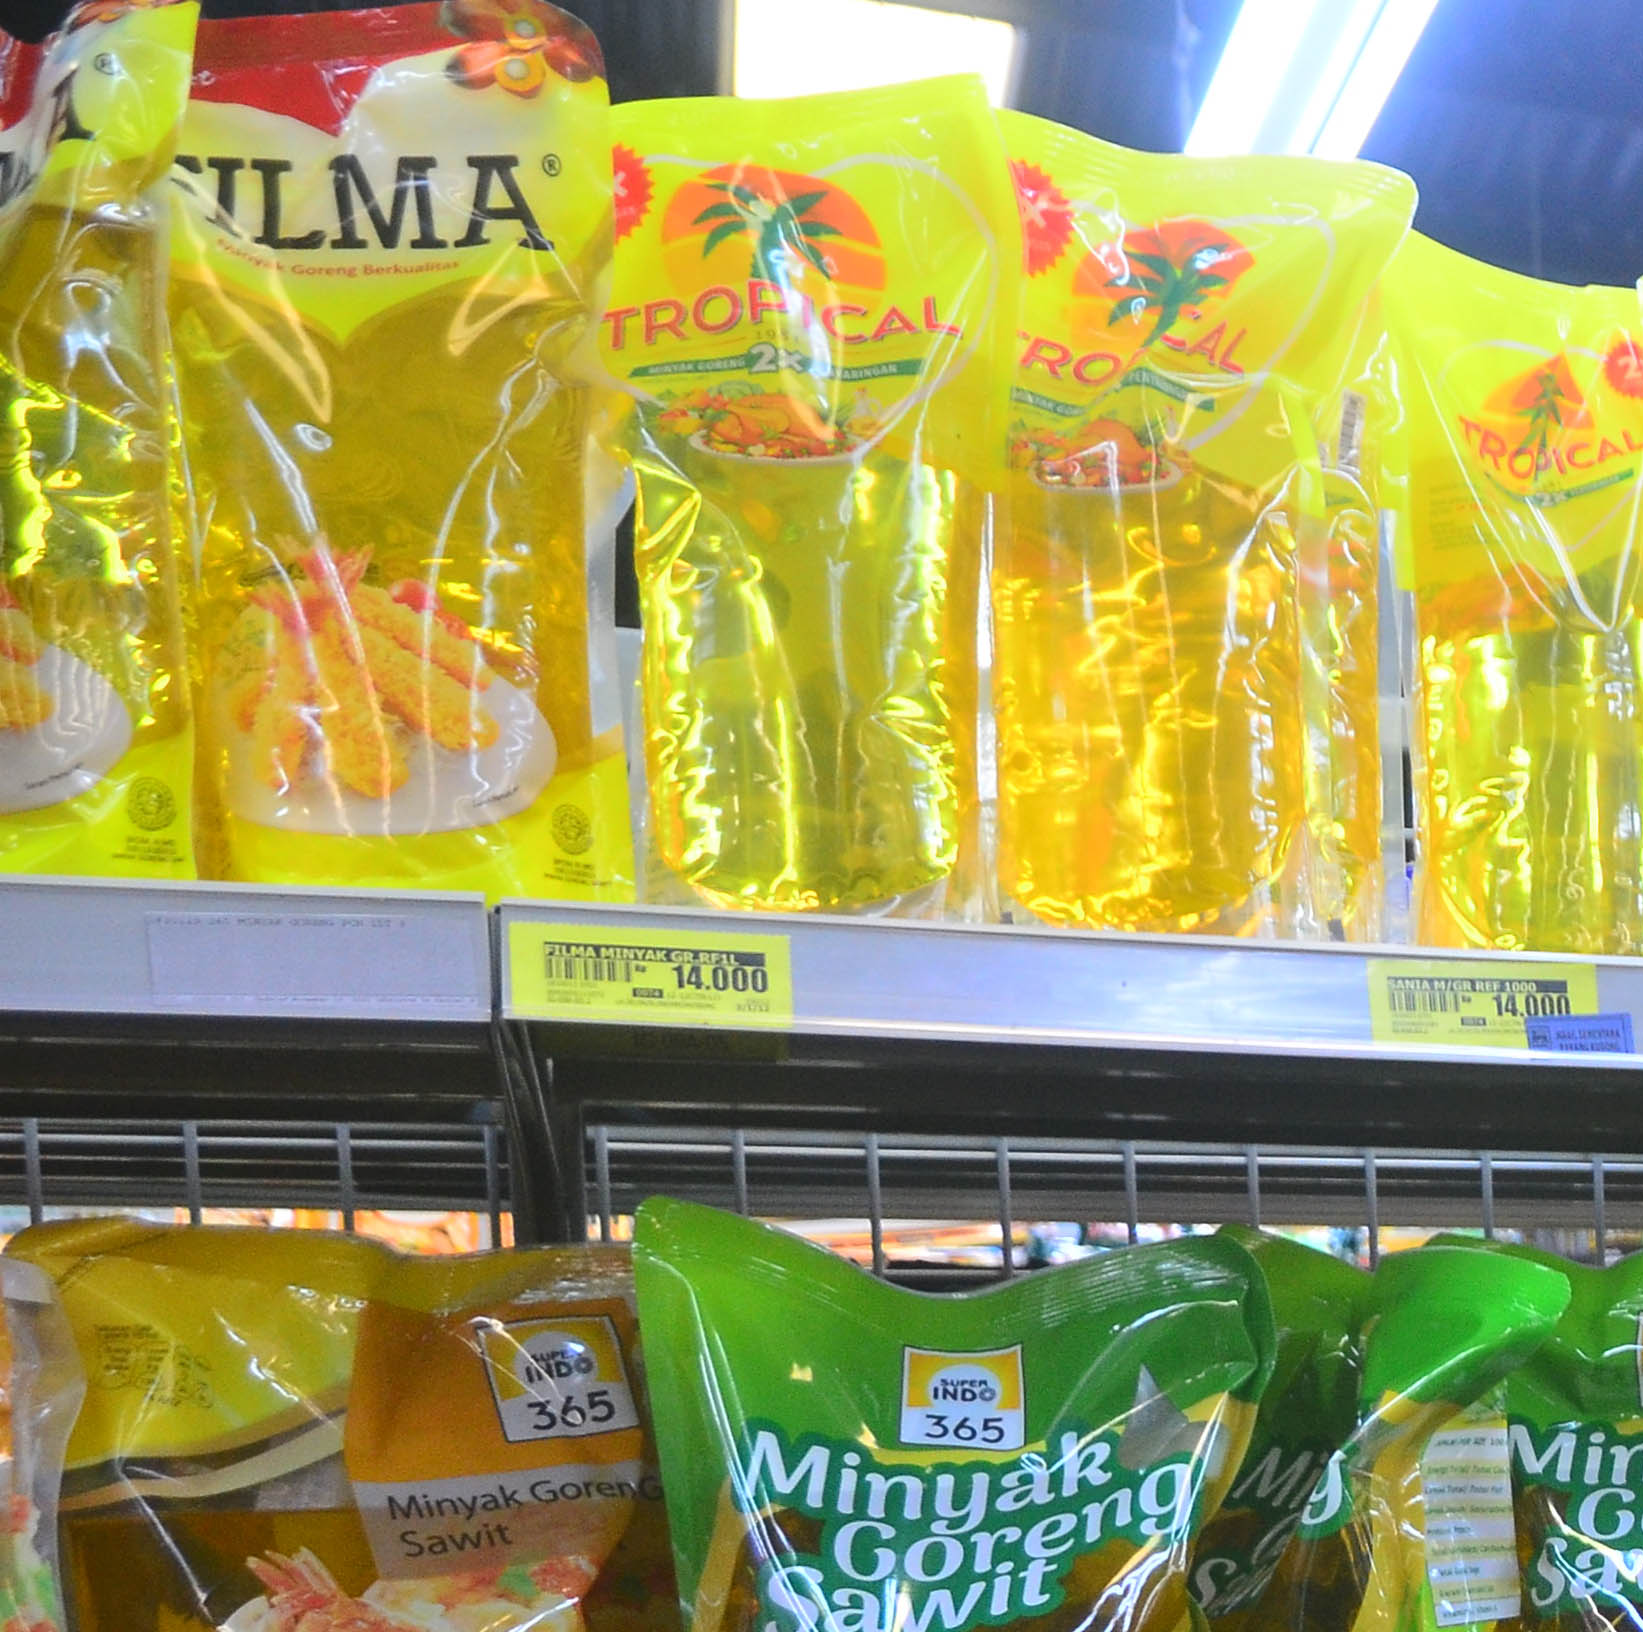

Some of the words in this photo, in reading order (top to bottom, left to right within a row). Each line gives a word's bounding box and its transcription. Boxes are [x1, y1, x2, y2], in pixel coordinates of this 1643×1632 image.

[290, 262, 359, 280] Goreng
[362, 259, 460, 278] Berkualitas
[600, 279, 964, 352] TROPICAL
[545, 943, 597, 959] FILMA
[600, 946, 667, 963] MINYAK
[672, 964, 769, 993] 14.000
[1492, 993, 1572, 1018] 14.000
[524, 1355, 594, 1384] INDO
[940, 1378, 989, 1389] SUPER
[931, 1386, 996, 1403] INDO
[527, 1389, 616, 1431] 365
[924, 1414, 1006, 1444] 365
[745, 1430, 1113, 1537] Minyak
[387, 1484, 523, 1521] Minyak
[832, 1461, 1194, 1584] Goreng
[400, 1523, 513, 1559] Sawit
